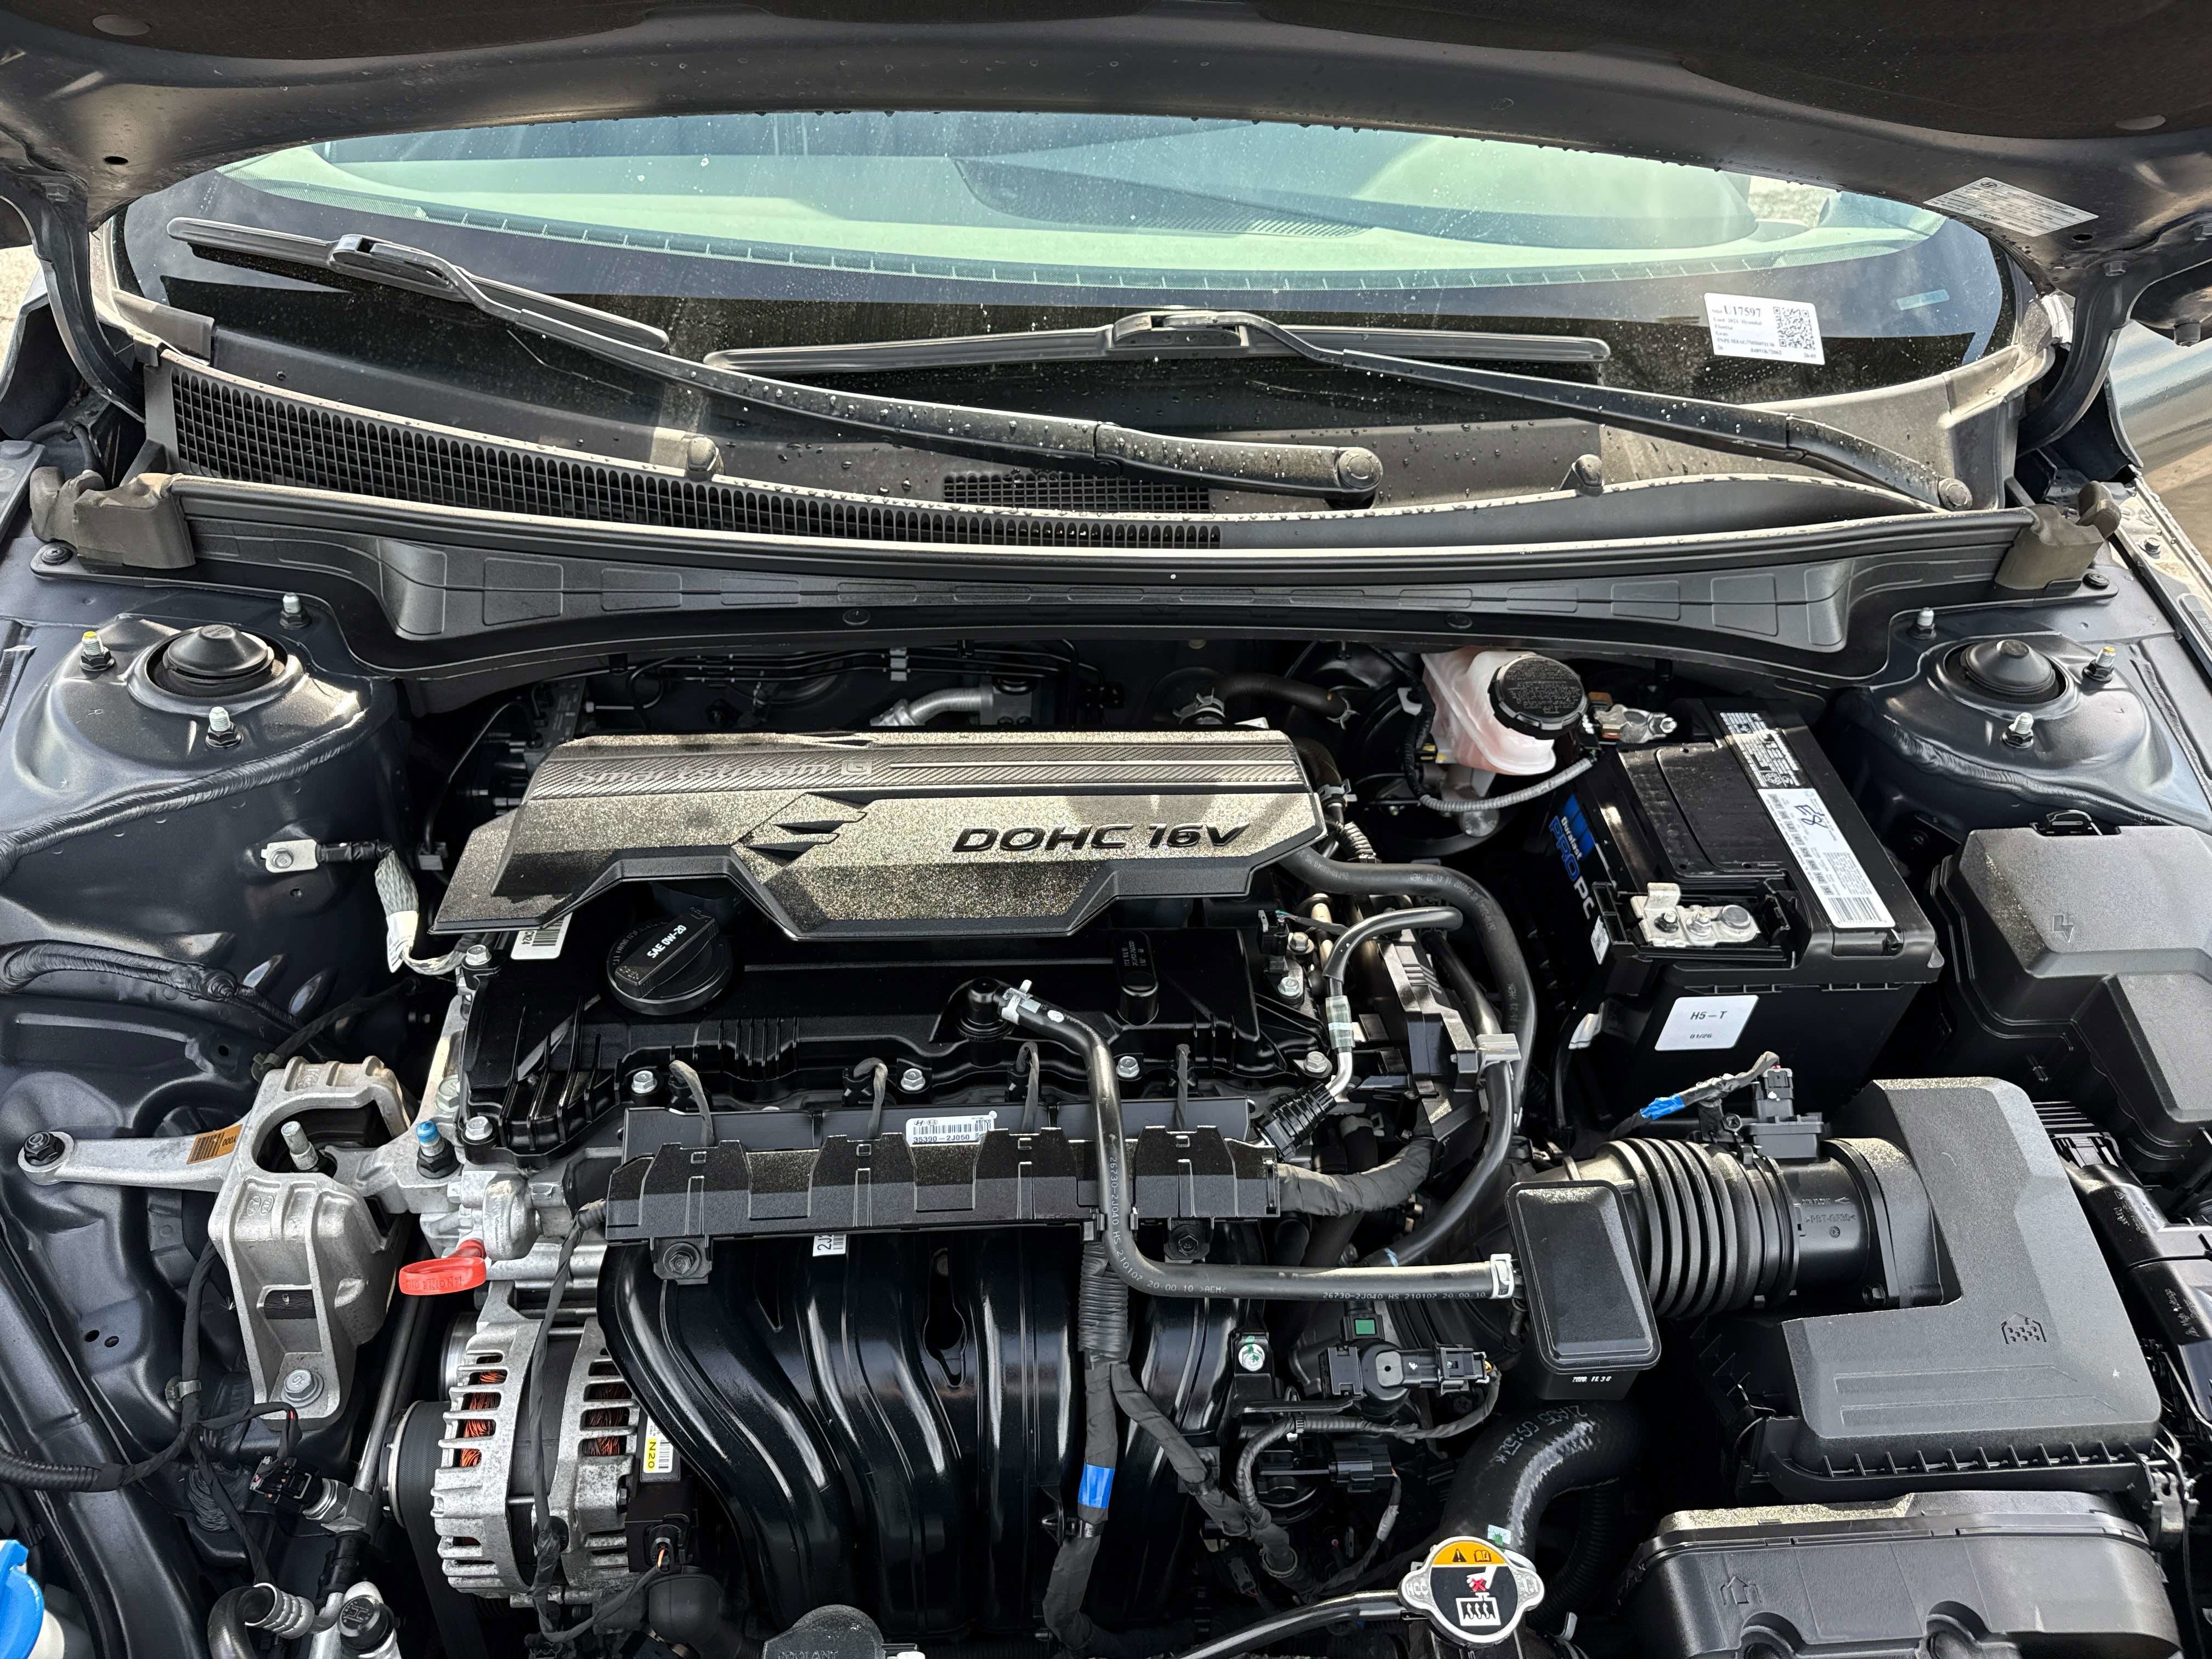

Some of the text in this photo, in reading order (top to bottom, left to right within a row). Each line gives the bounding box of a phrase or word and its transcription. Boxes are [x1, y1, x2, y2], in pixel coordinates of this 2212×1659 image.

[574, 762, 831, 785] Smartstream
[952, 823, 1251, 852] DOHC 16V
[1561, 816, 1583, 860] Duralast
[647, 943, 666, 958] SAE
[661, 924, 687, 946] 0W-20
[1110, 1156, 1120, 1225] 26730-2J040
[817, 1234, 832, 1251] 2J
[1113, 1231, 1121, 1244] HS
[422, 1274, 462, 1291] ENGINE
